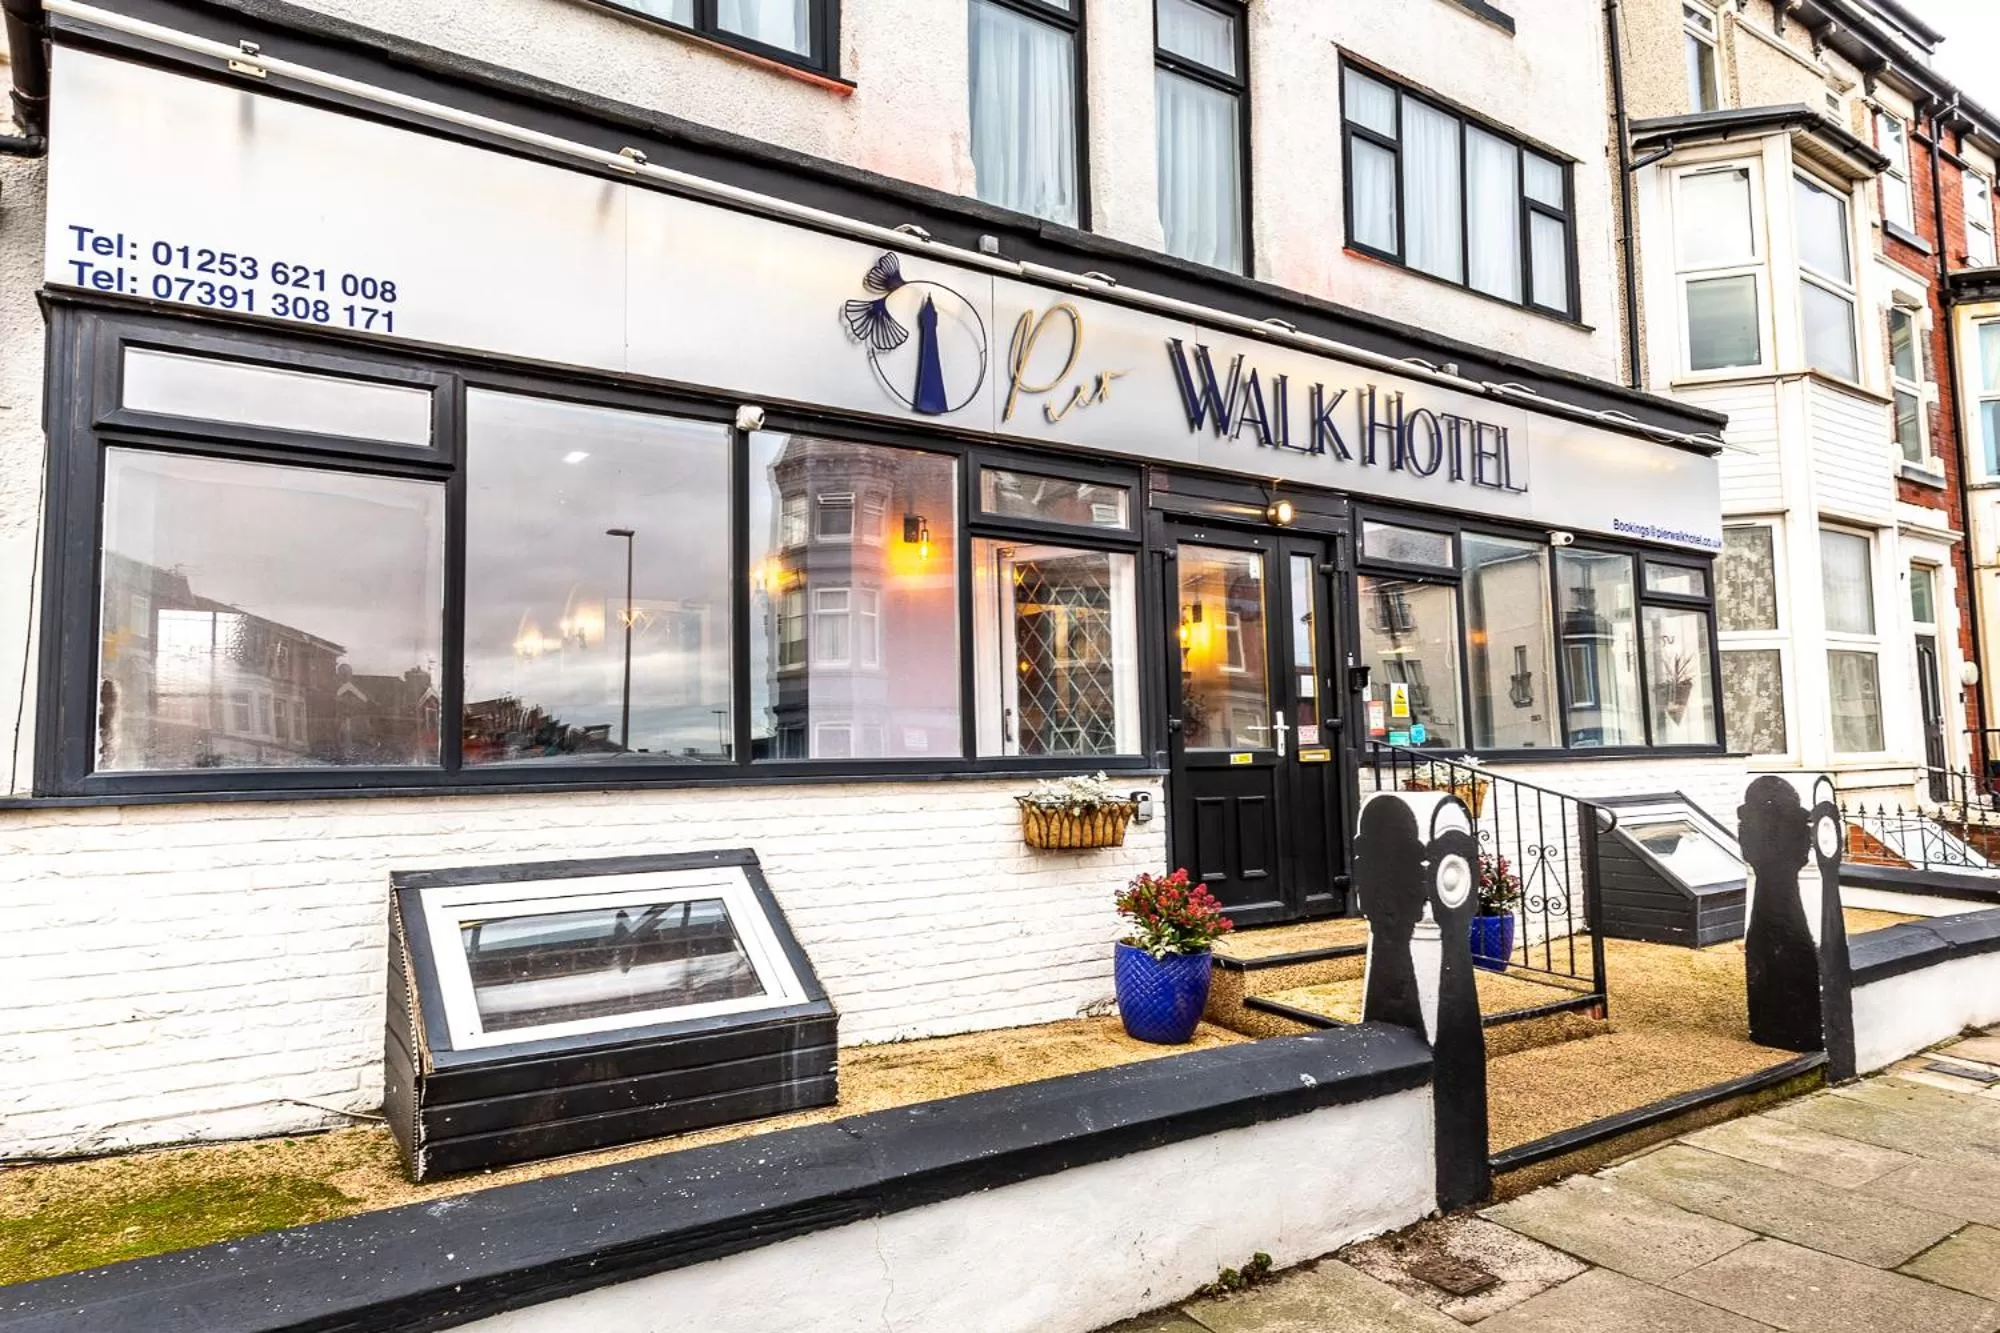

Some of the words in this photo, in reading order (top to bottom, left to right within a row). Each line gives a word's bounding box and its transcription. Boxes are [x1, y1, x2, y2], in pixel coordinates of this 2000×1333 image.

[68, 225, 138, 261] Tel:
[152, 240, 259, 281] 01253
[270, 261, 326, 292] 621
[341, 273, 397, 303] 008
[68, 260, 138, 295] Tel:
[152, 273, 255, 312] 07391
[270, 293, 330, 323] 308
[343, 304, 394, 333] 171
[1165, 338, 1353, 460] WALK
[1356, 383, 1528, 493] HOTEL
